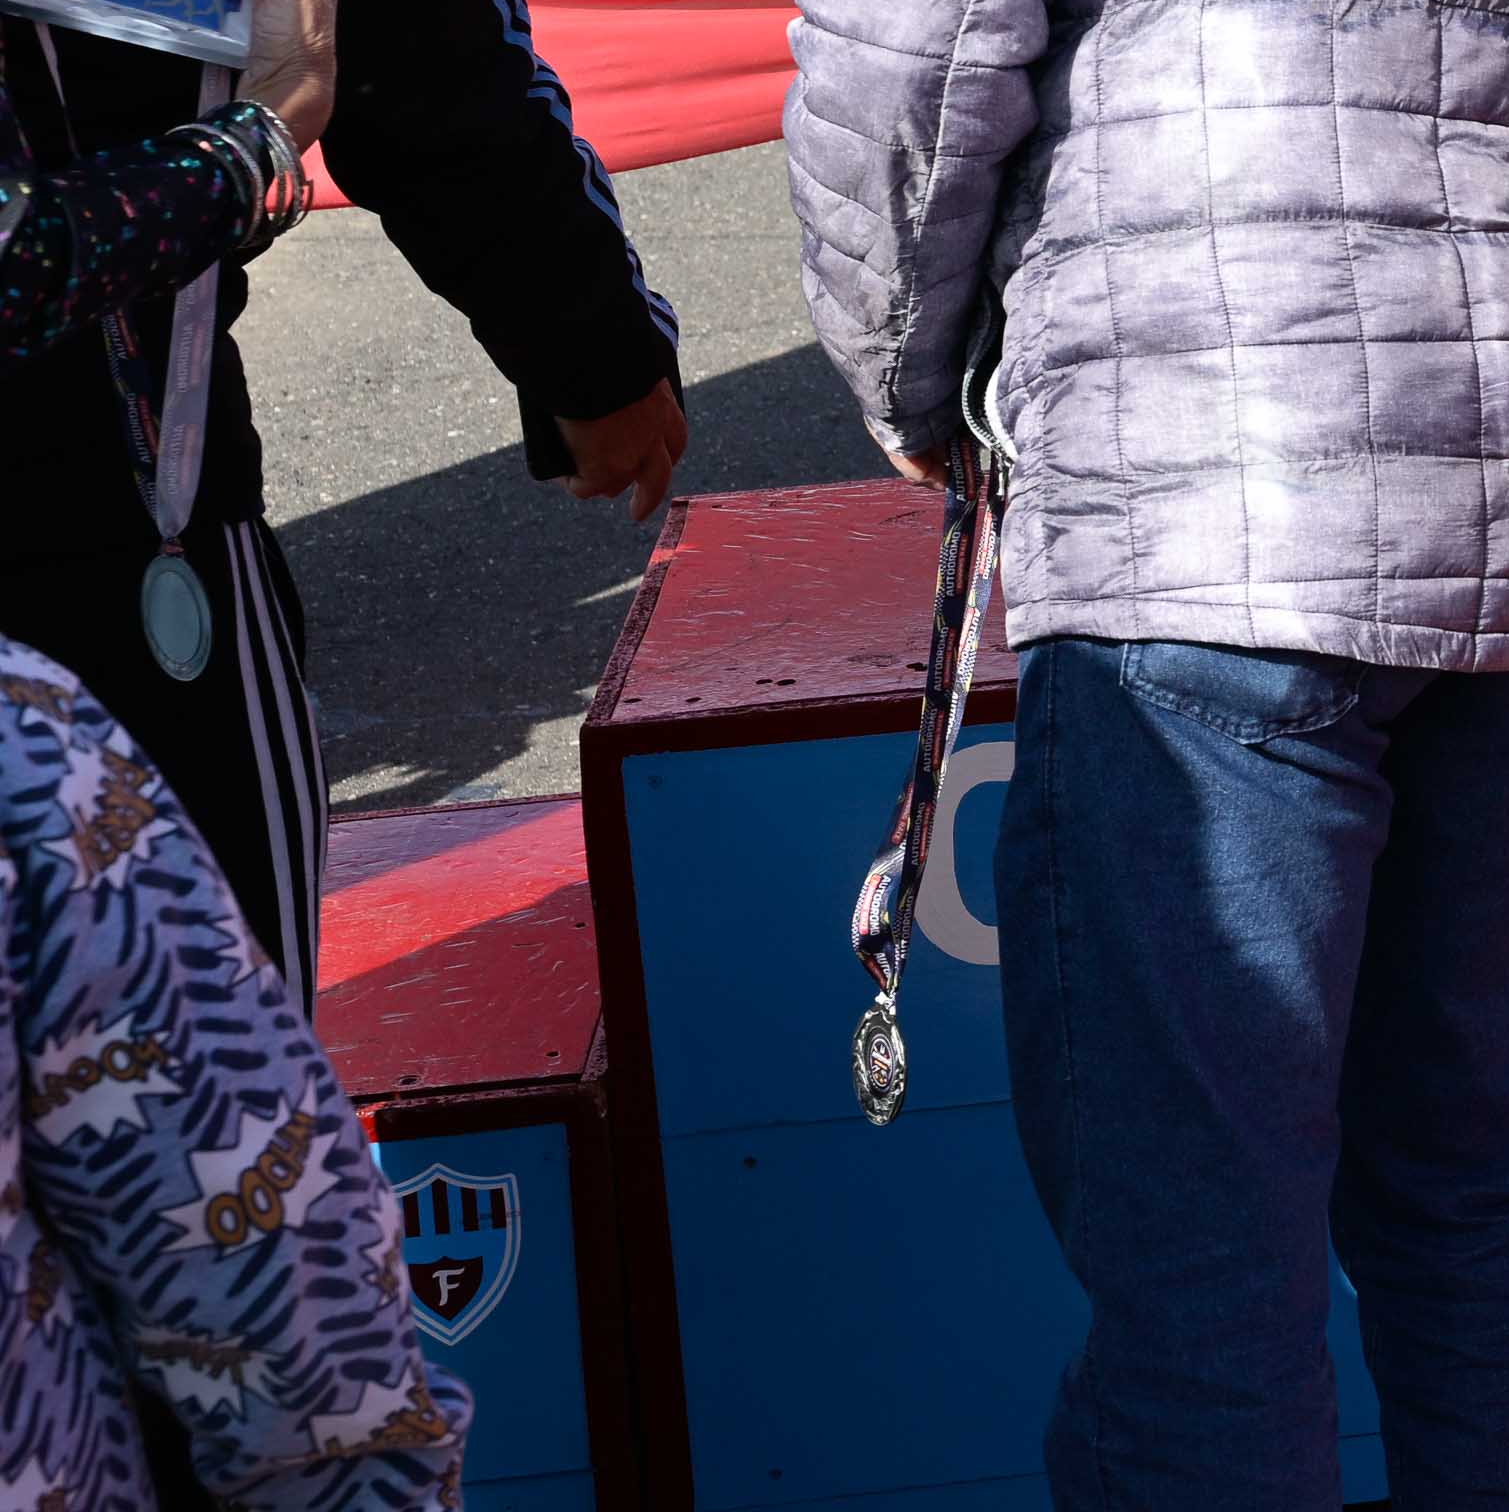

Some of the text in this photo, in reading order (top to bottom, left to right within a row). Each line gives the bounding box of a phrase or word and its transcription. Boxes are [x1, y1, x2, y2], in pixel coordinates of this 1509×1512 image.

[944, 530, 961, 598] AUTODROMO
[933, 625, 949, 692] AUTODROMO
[922, 706, 938, 774] AUTODROMO
[911, 800, 926, 868] AUTODROMO
[869, 873, 892, 938] AUTODROMO
[432, 1266, 466, 1307] F
